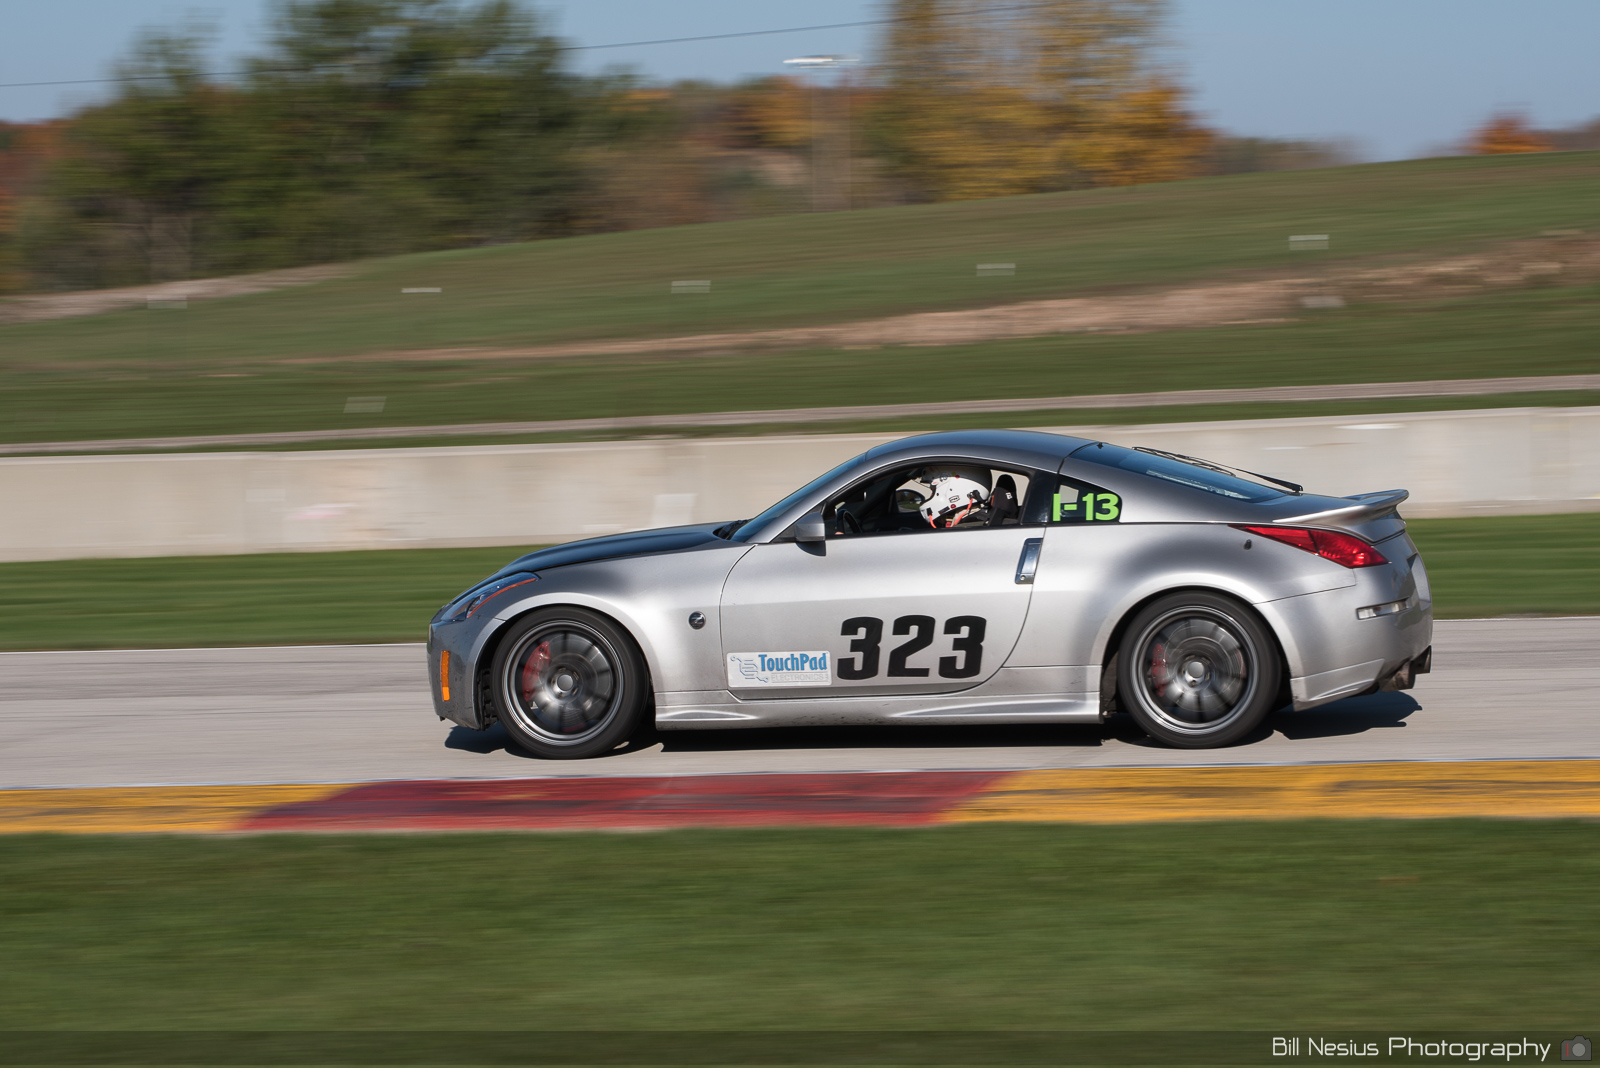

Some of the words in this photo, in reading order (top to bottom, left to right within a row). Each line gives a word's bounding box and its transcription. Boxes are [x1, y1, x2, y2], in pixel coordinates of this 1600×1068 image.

[1053, 493, 1119, 521] I-13
[837, 614, 987, 681] 323
[758, 653, 828, 672] TouchPad
